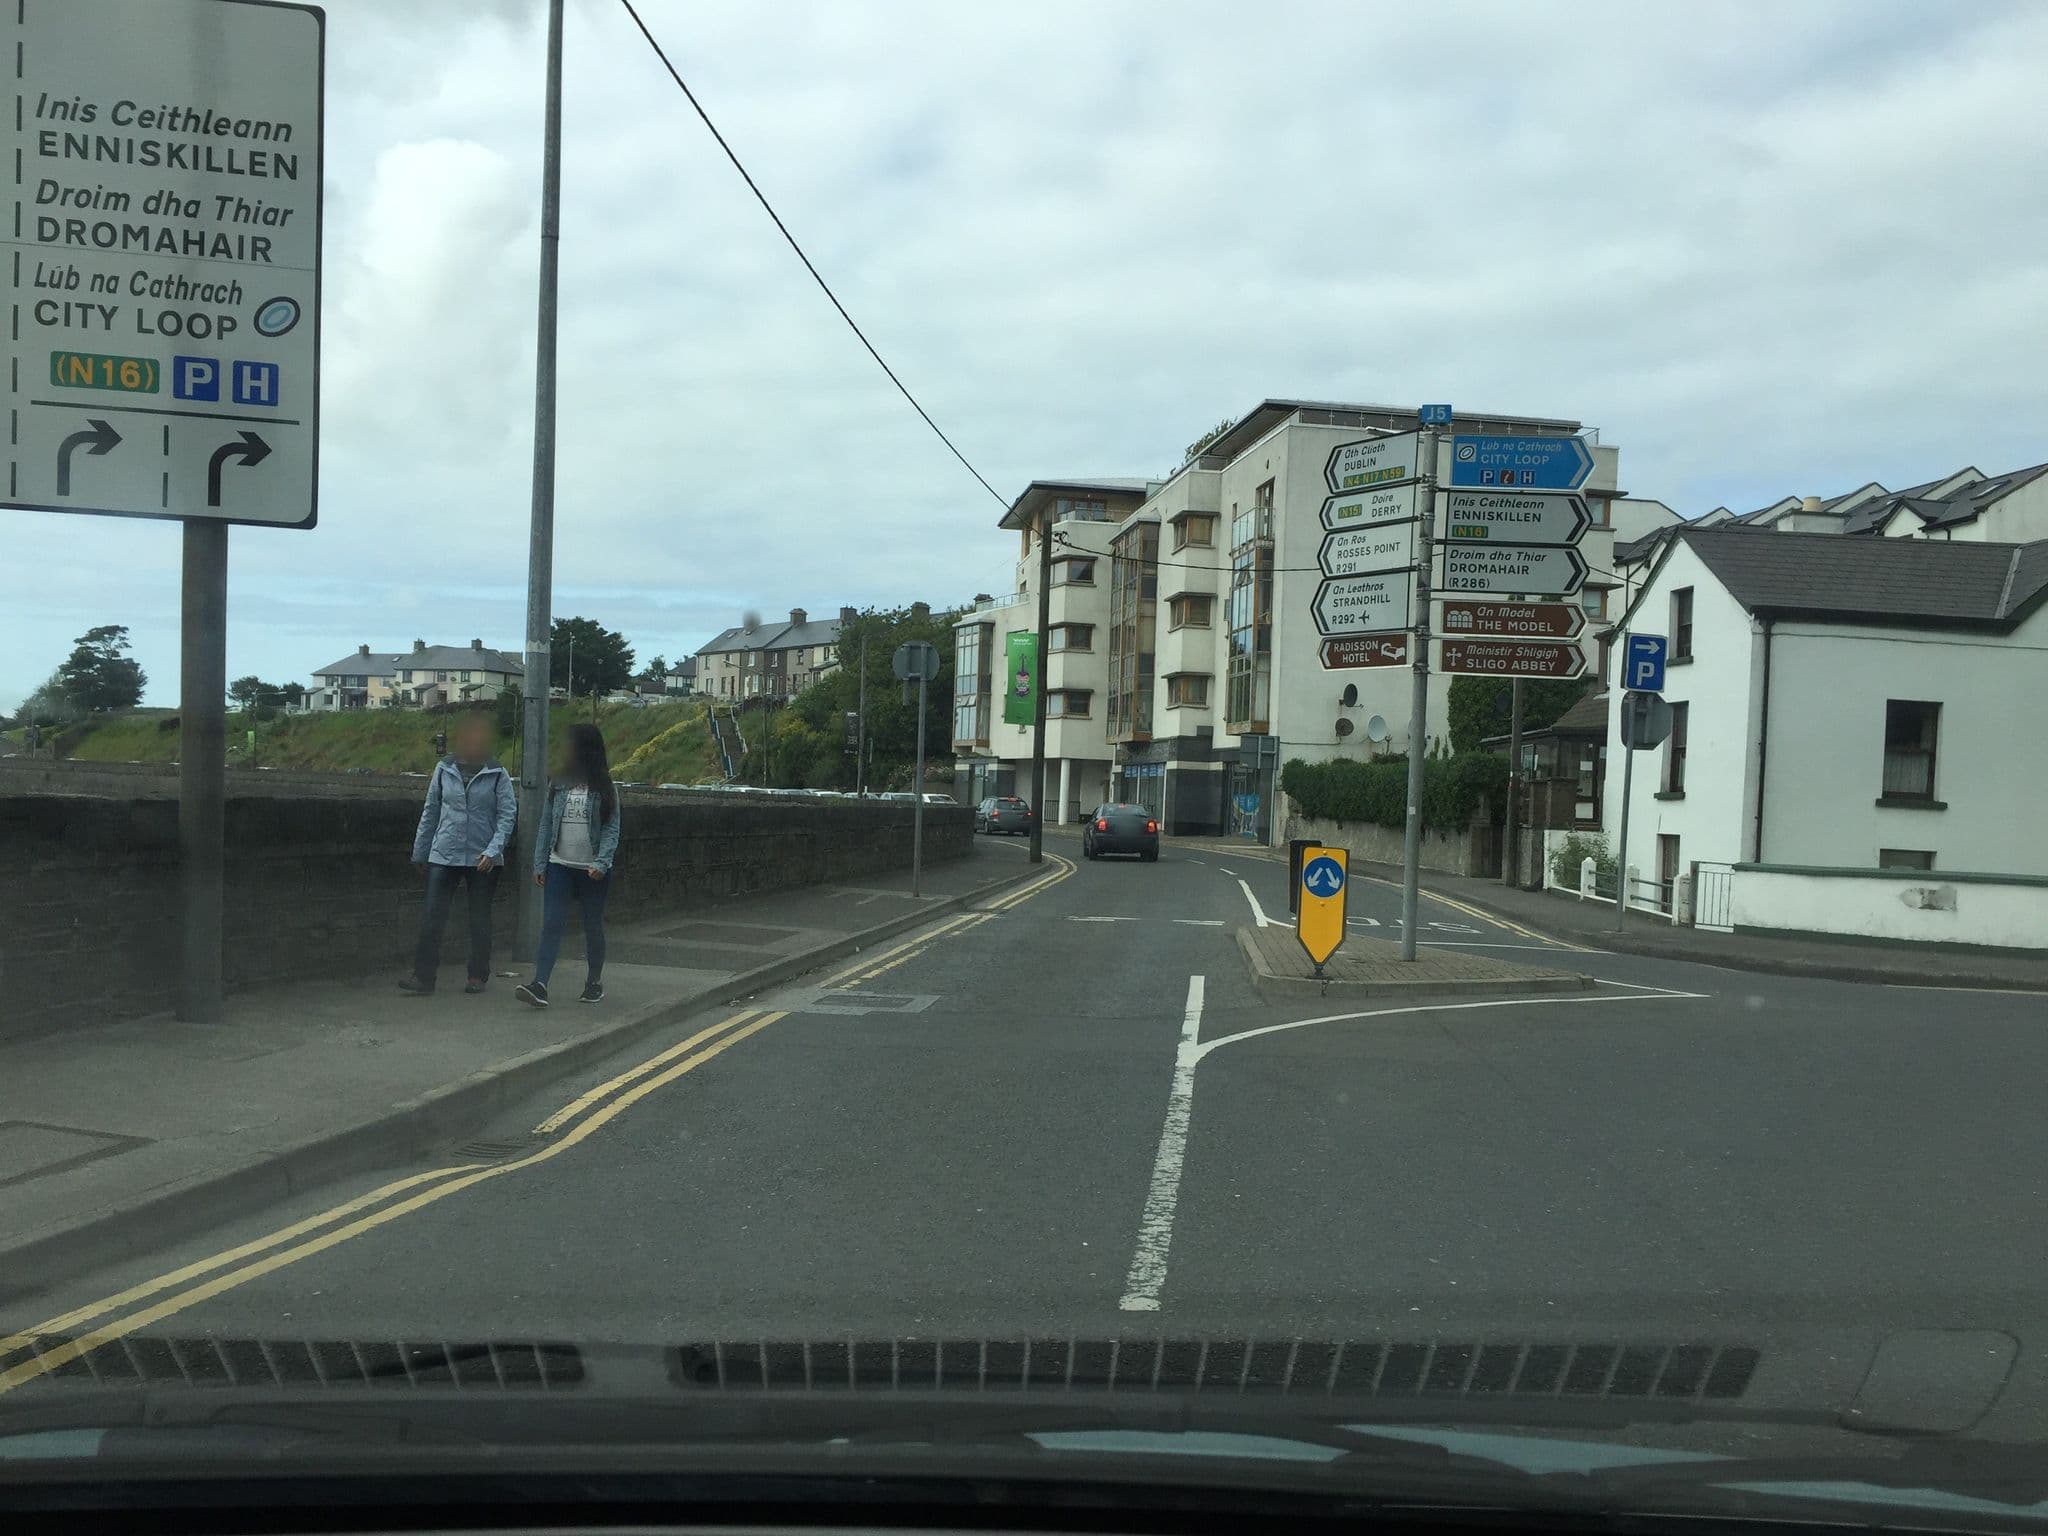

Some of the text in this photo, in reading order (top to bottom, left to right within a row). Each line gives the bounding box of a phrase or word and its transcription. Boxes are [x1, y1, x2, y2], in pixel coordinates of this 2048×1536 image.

[35, 92, 293, 143] Inis Ceithleann
[38, 130, 298, 181] ENNISKILLEN
[35, 178, 294, 228] Droim dha Thiar
[37, 215, 273, 263] DROMAHAIR
[33, 261, 243, 306] Lúb na Cathrach
[34, 299, 238, 341] CITY LOOP
[184, 360, 213, 397] P
[241, 365, 269, 402] H
[1517, 440, 1562, 452] Cathrach
[1344, 457, 1377, 471] DUBLIN
[1481, 454, 1550, 465] CITY LOOP
[1483, 470, 1494, 483] P
[1522, 471, 1533, 484] H
[1453, 496, 1545, 509] Inis Ceithleann
[1371, 504, 1401, 517] DERRY
[1453, 510, 1542, 522] ENNISKILLEN
[1351, 535, 1367, 545] Ros
[1337, 542, 1401, 559] ROSSES POINT
[1450, 549, 1486, 560] Droim
[1516, 551, 1547, 562] Thiar
[1449, 562, 1530, 575] DROMAHAIR
[1333, 593, 1391, 607] STRANDHILL
[1498, 607, 1536, 618] Model
[1477, 620, 1554, 632] THE MODEL
[1334, 640, 1379, 653] RADISSON
[1466, 644, 1559, 660] Mainistir Shligigh
[1342, 652, 1370, 663] HOTEL
[1466, 659, 1556, 672] SLIGO ABBEY
[1636, 661, 1655, 686] P
